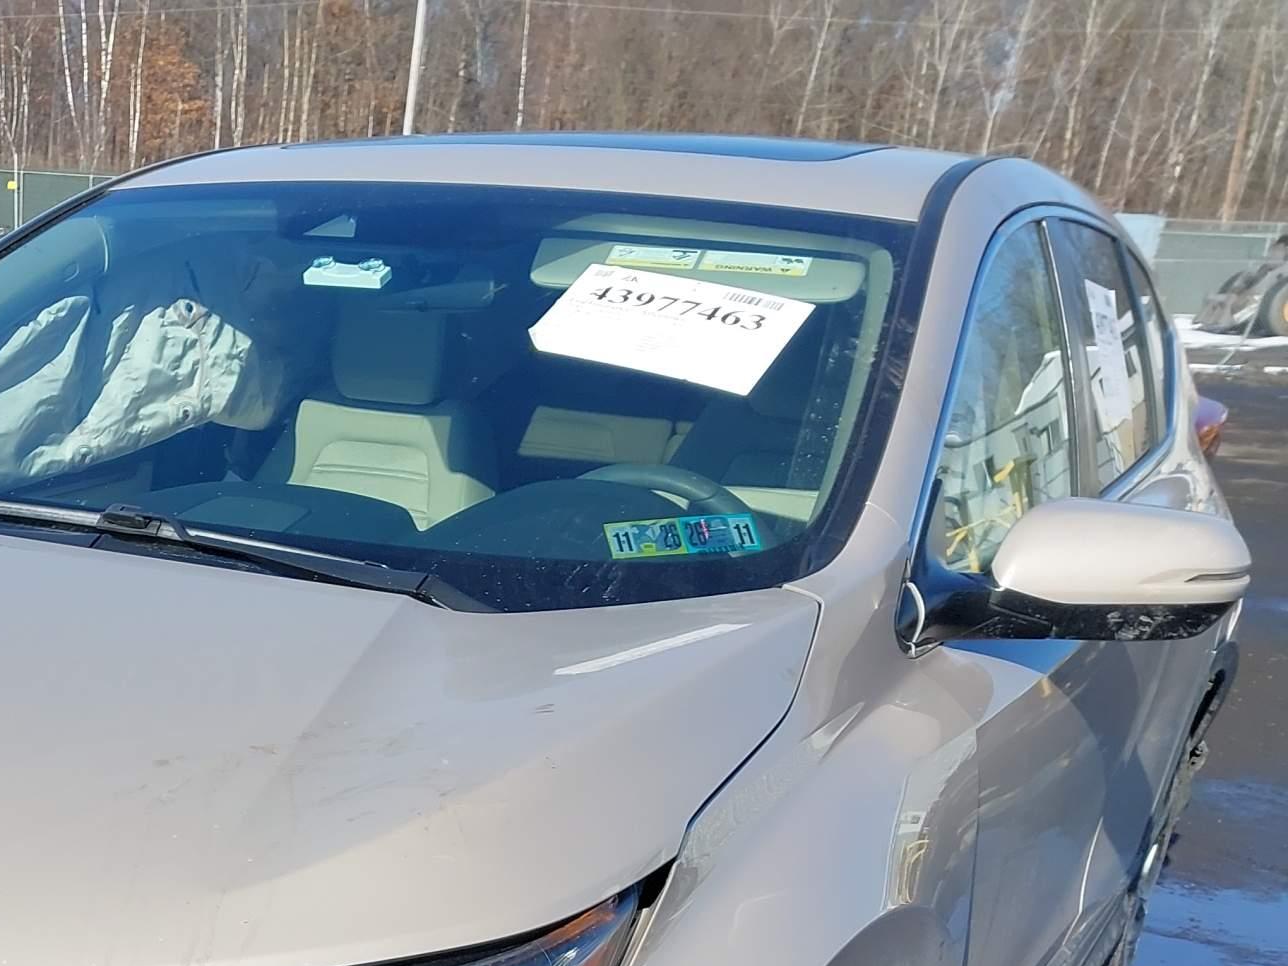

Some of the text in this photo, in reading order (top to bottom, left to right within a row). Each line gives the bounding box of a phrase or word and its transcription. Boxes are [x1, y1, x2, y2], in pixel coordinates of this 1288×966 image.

[589, 286, 767, 331] 43977463
[612, 531, 634, 553] 11
[733, 523, 755, 545] 11
